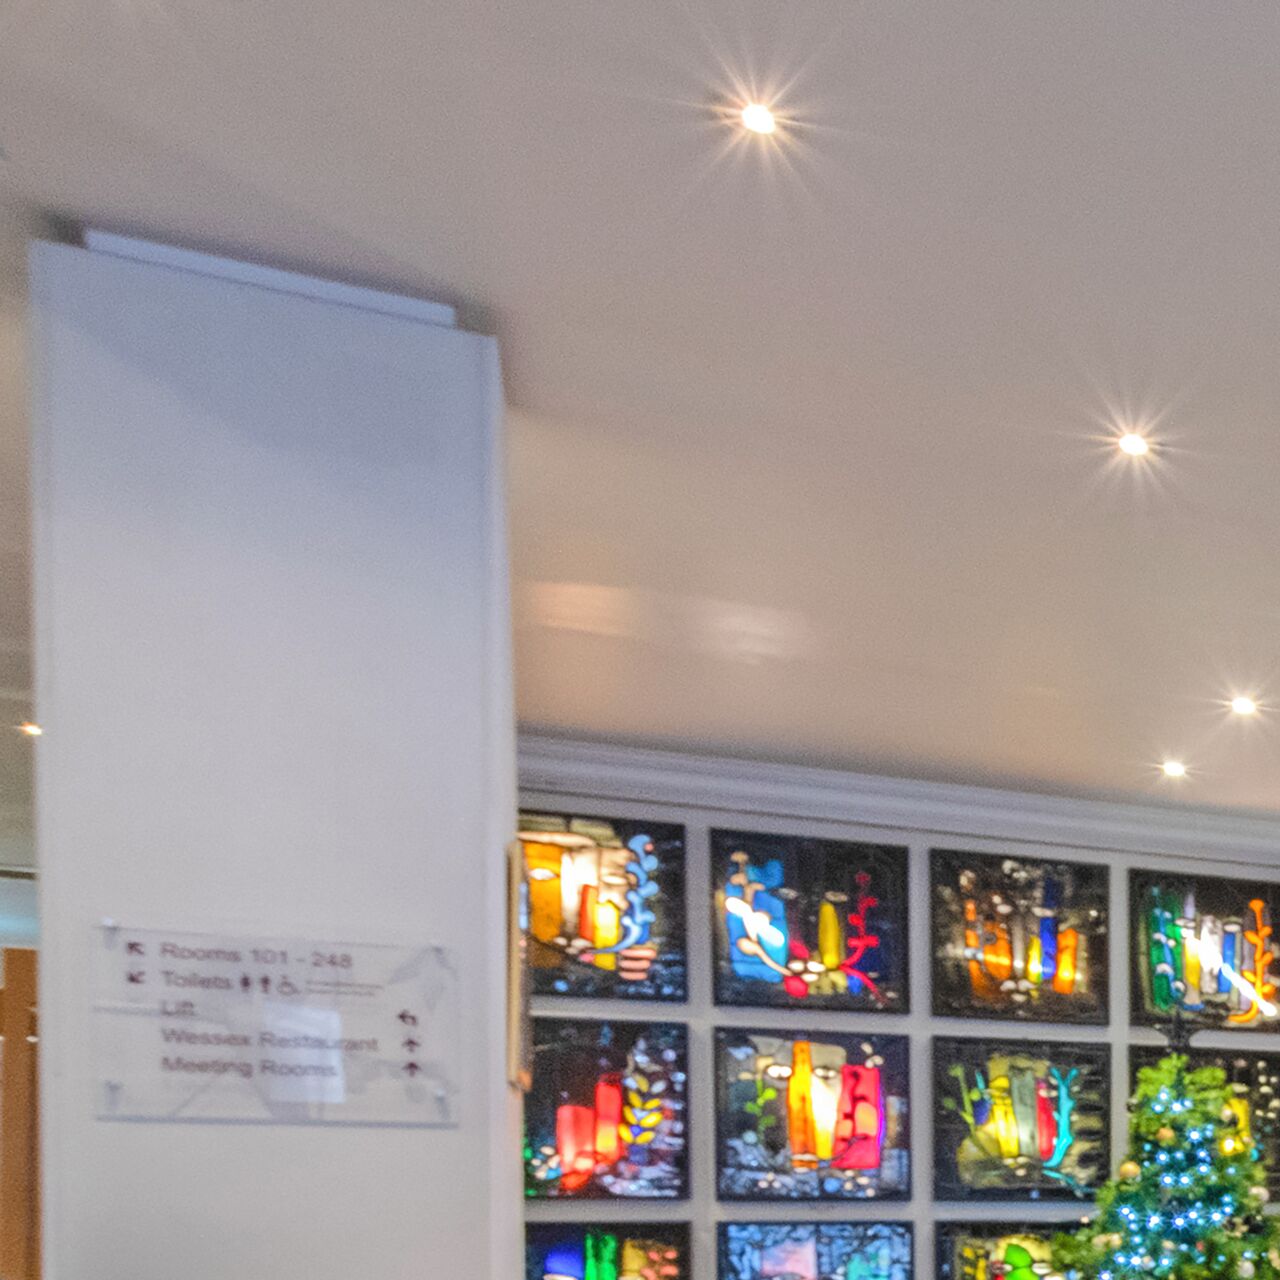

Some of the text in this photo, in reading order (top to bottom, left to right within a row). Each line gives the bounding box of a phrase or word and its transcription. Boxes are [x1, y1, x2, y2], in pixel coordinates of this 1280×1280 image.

[159, 941, 242, 965] Rooms
[251, 947, 289, 966] 101
[311, 950, 353, 969] 248
[161, 970, 233, 990] Toilets
[161, 1027, 379, 1053] Wessex Restaurant
[161, 1055, 338, 1080] Meeting Rooms
